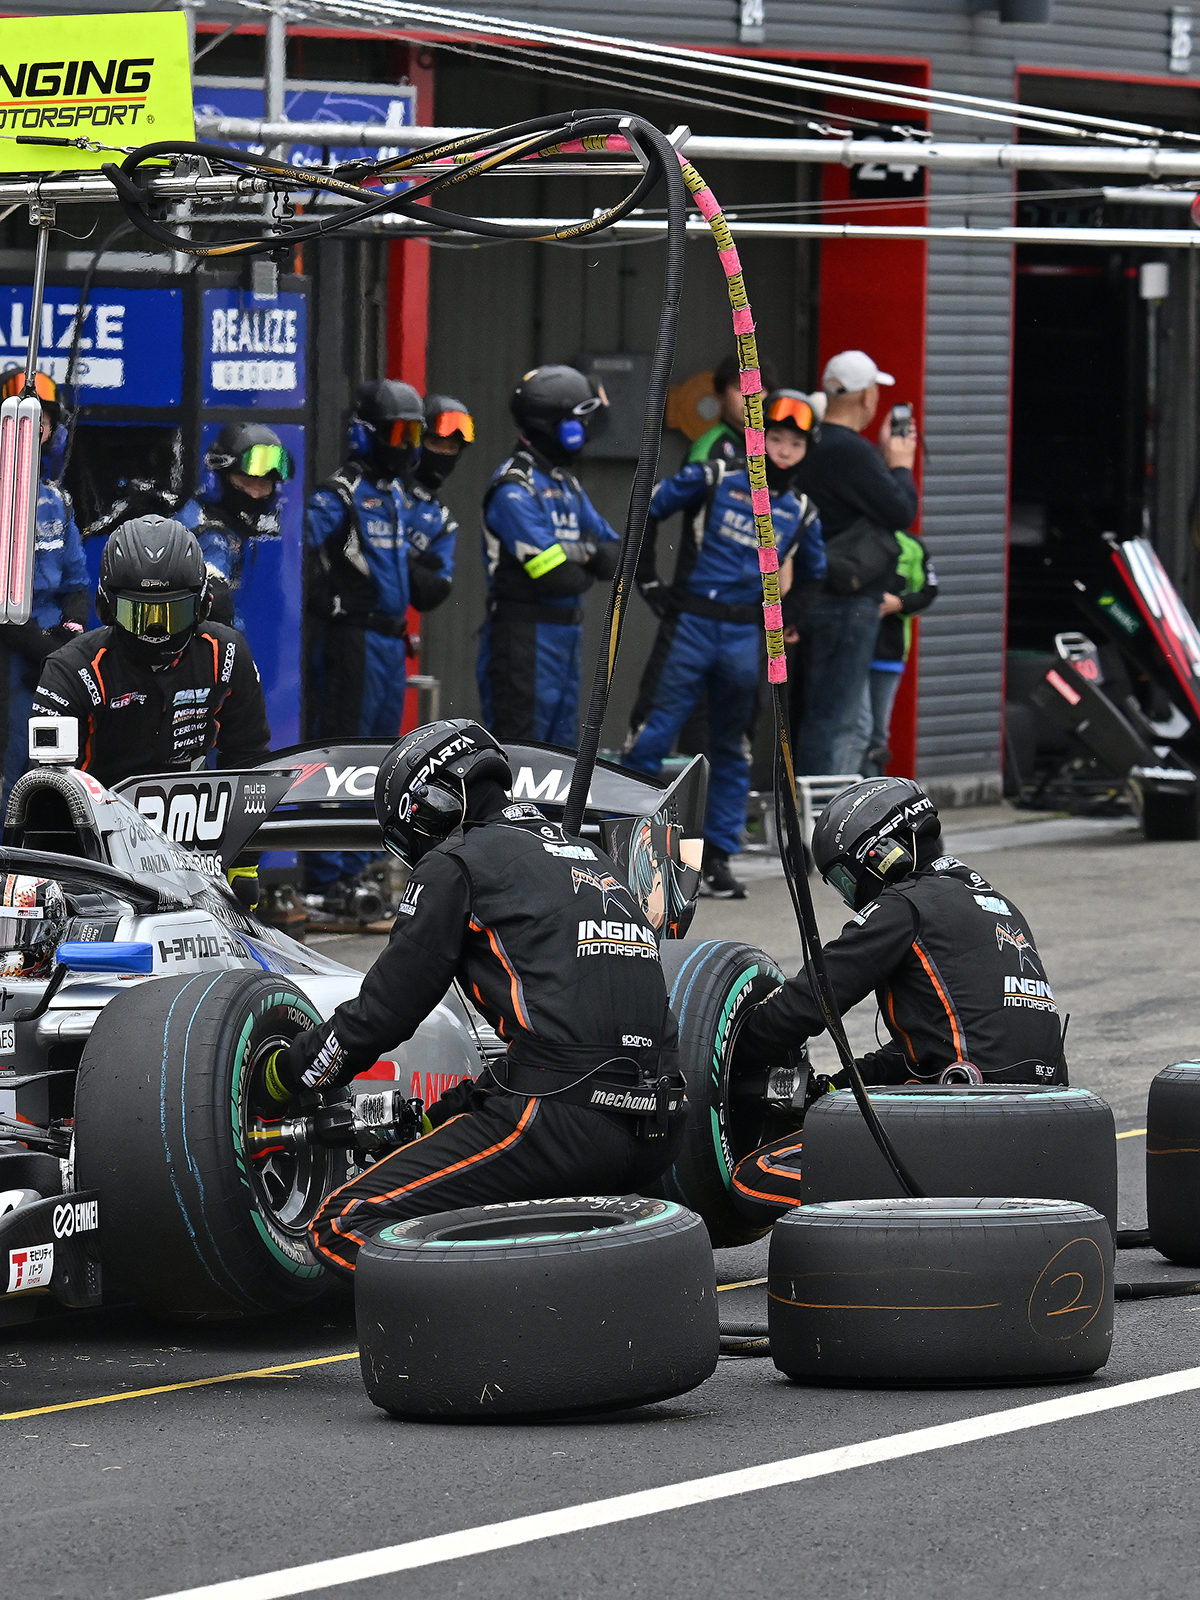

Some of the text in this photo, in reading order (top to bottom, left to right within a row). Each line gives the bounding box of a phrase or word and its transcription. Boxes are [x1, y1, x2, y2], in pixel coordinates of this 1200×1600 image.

[212, 308, 297, 354] REALIZE
[221, 642, 235, 683] sparco
[77, 667, 102, 706] sparco
[409, 734, 476, 792] SPARTA
[243, 783, 266, 795] muta
[878, 796, 934, 837] SPARTA
[577, 920, 657, 946] INGING
[1004, 976, 1055, 1000] INGIN
[287, 1006, 316, 1031] YOKOHA
[720, 980, 754, 1061] ADVAN
[621, 1034, 654, 1048] sparco
[301, 1029, 340, 1088] INGING
[74, 1200, 98, 1233] ENKEI
[482, 1195, 603, 1211] ADVAN
[28, 1263, 44, 1277] パーツ
[29, 1248, 53, 1262] モビリティ
[1045, 1271, 1092, 1317] 2
